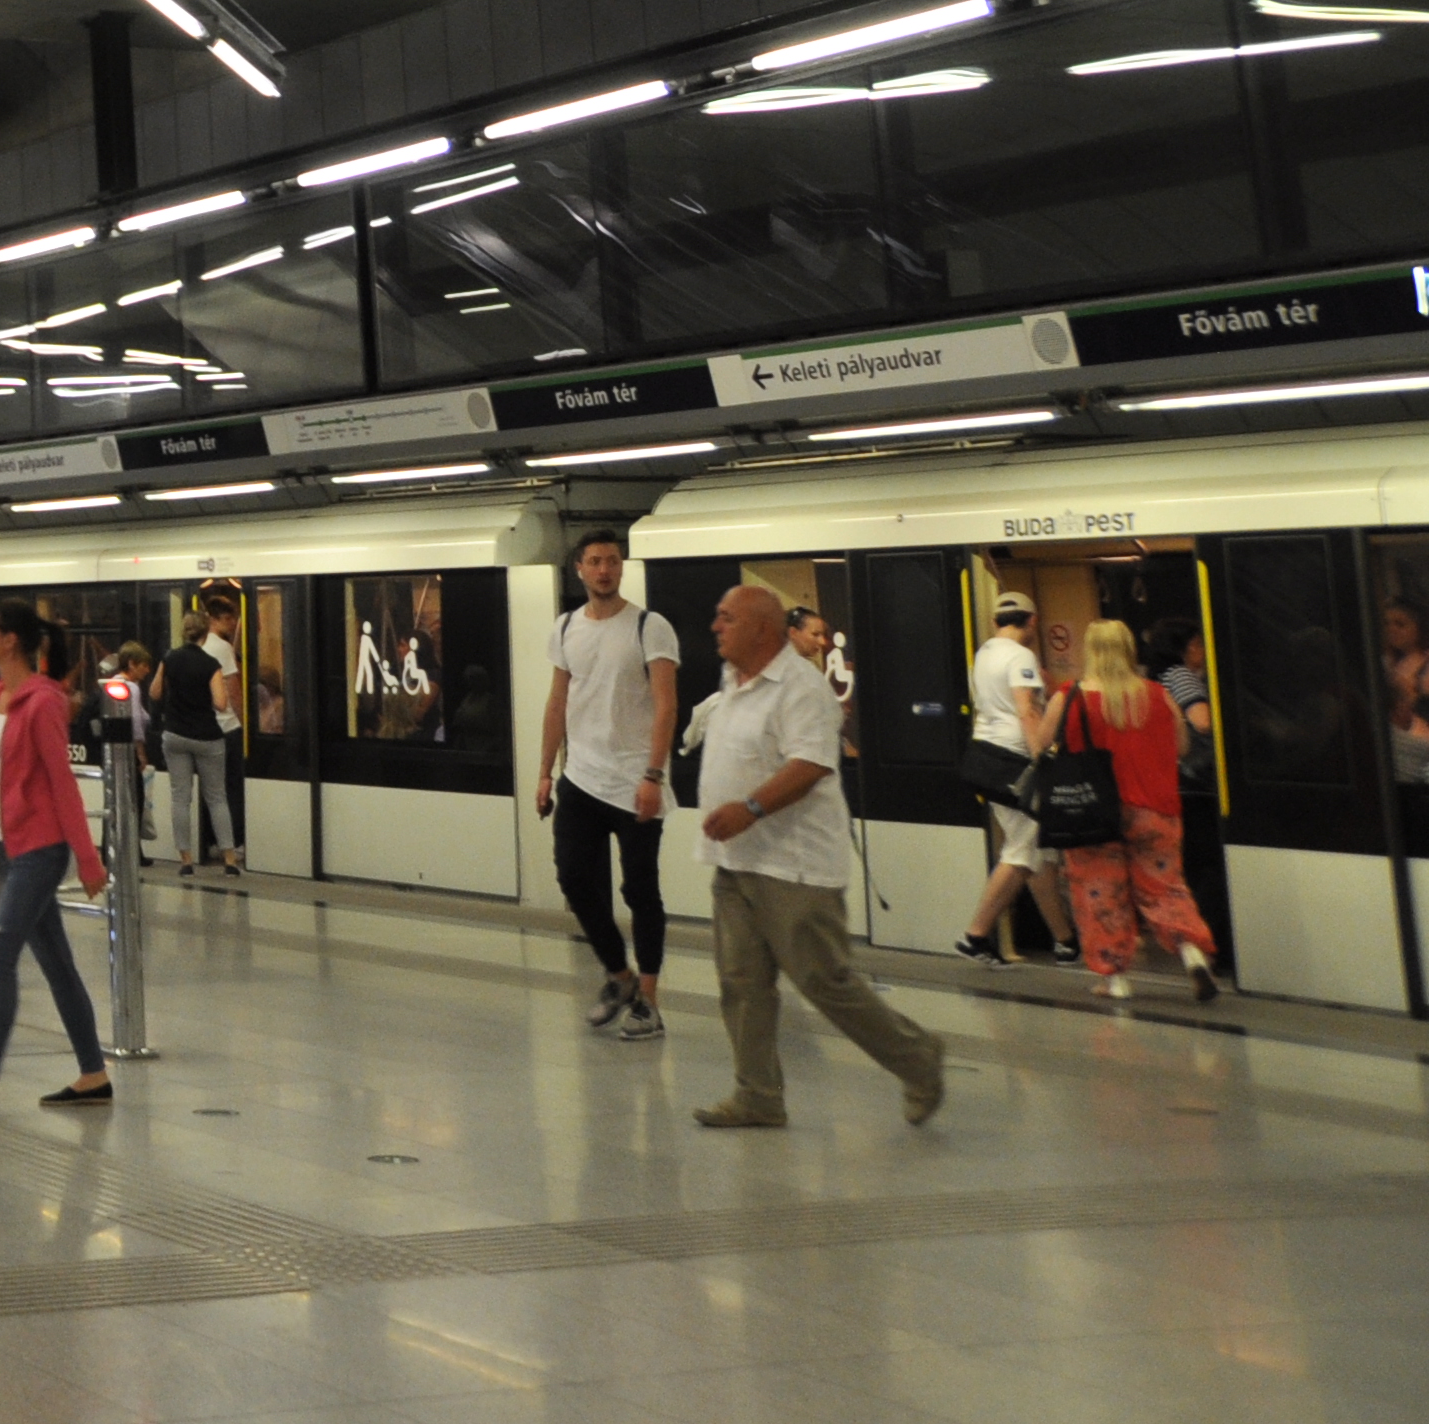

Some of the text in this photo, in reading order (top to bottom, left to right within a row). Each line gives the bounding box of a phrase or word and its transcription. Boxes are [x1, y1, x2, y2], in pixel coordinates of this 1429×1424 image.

[1177, 299, 1320, 336] Fővám tér
[778, 347, 943, 384] Keleti pályaudvar
[554, 382, 638, 410] Fővám tér
